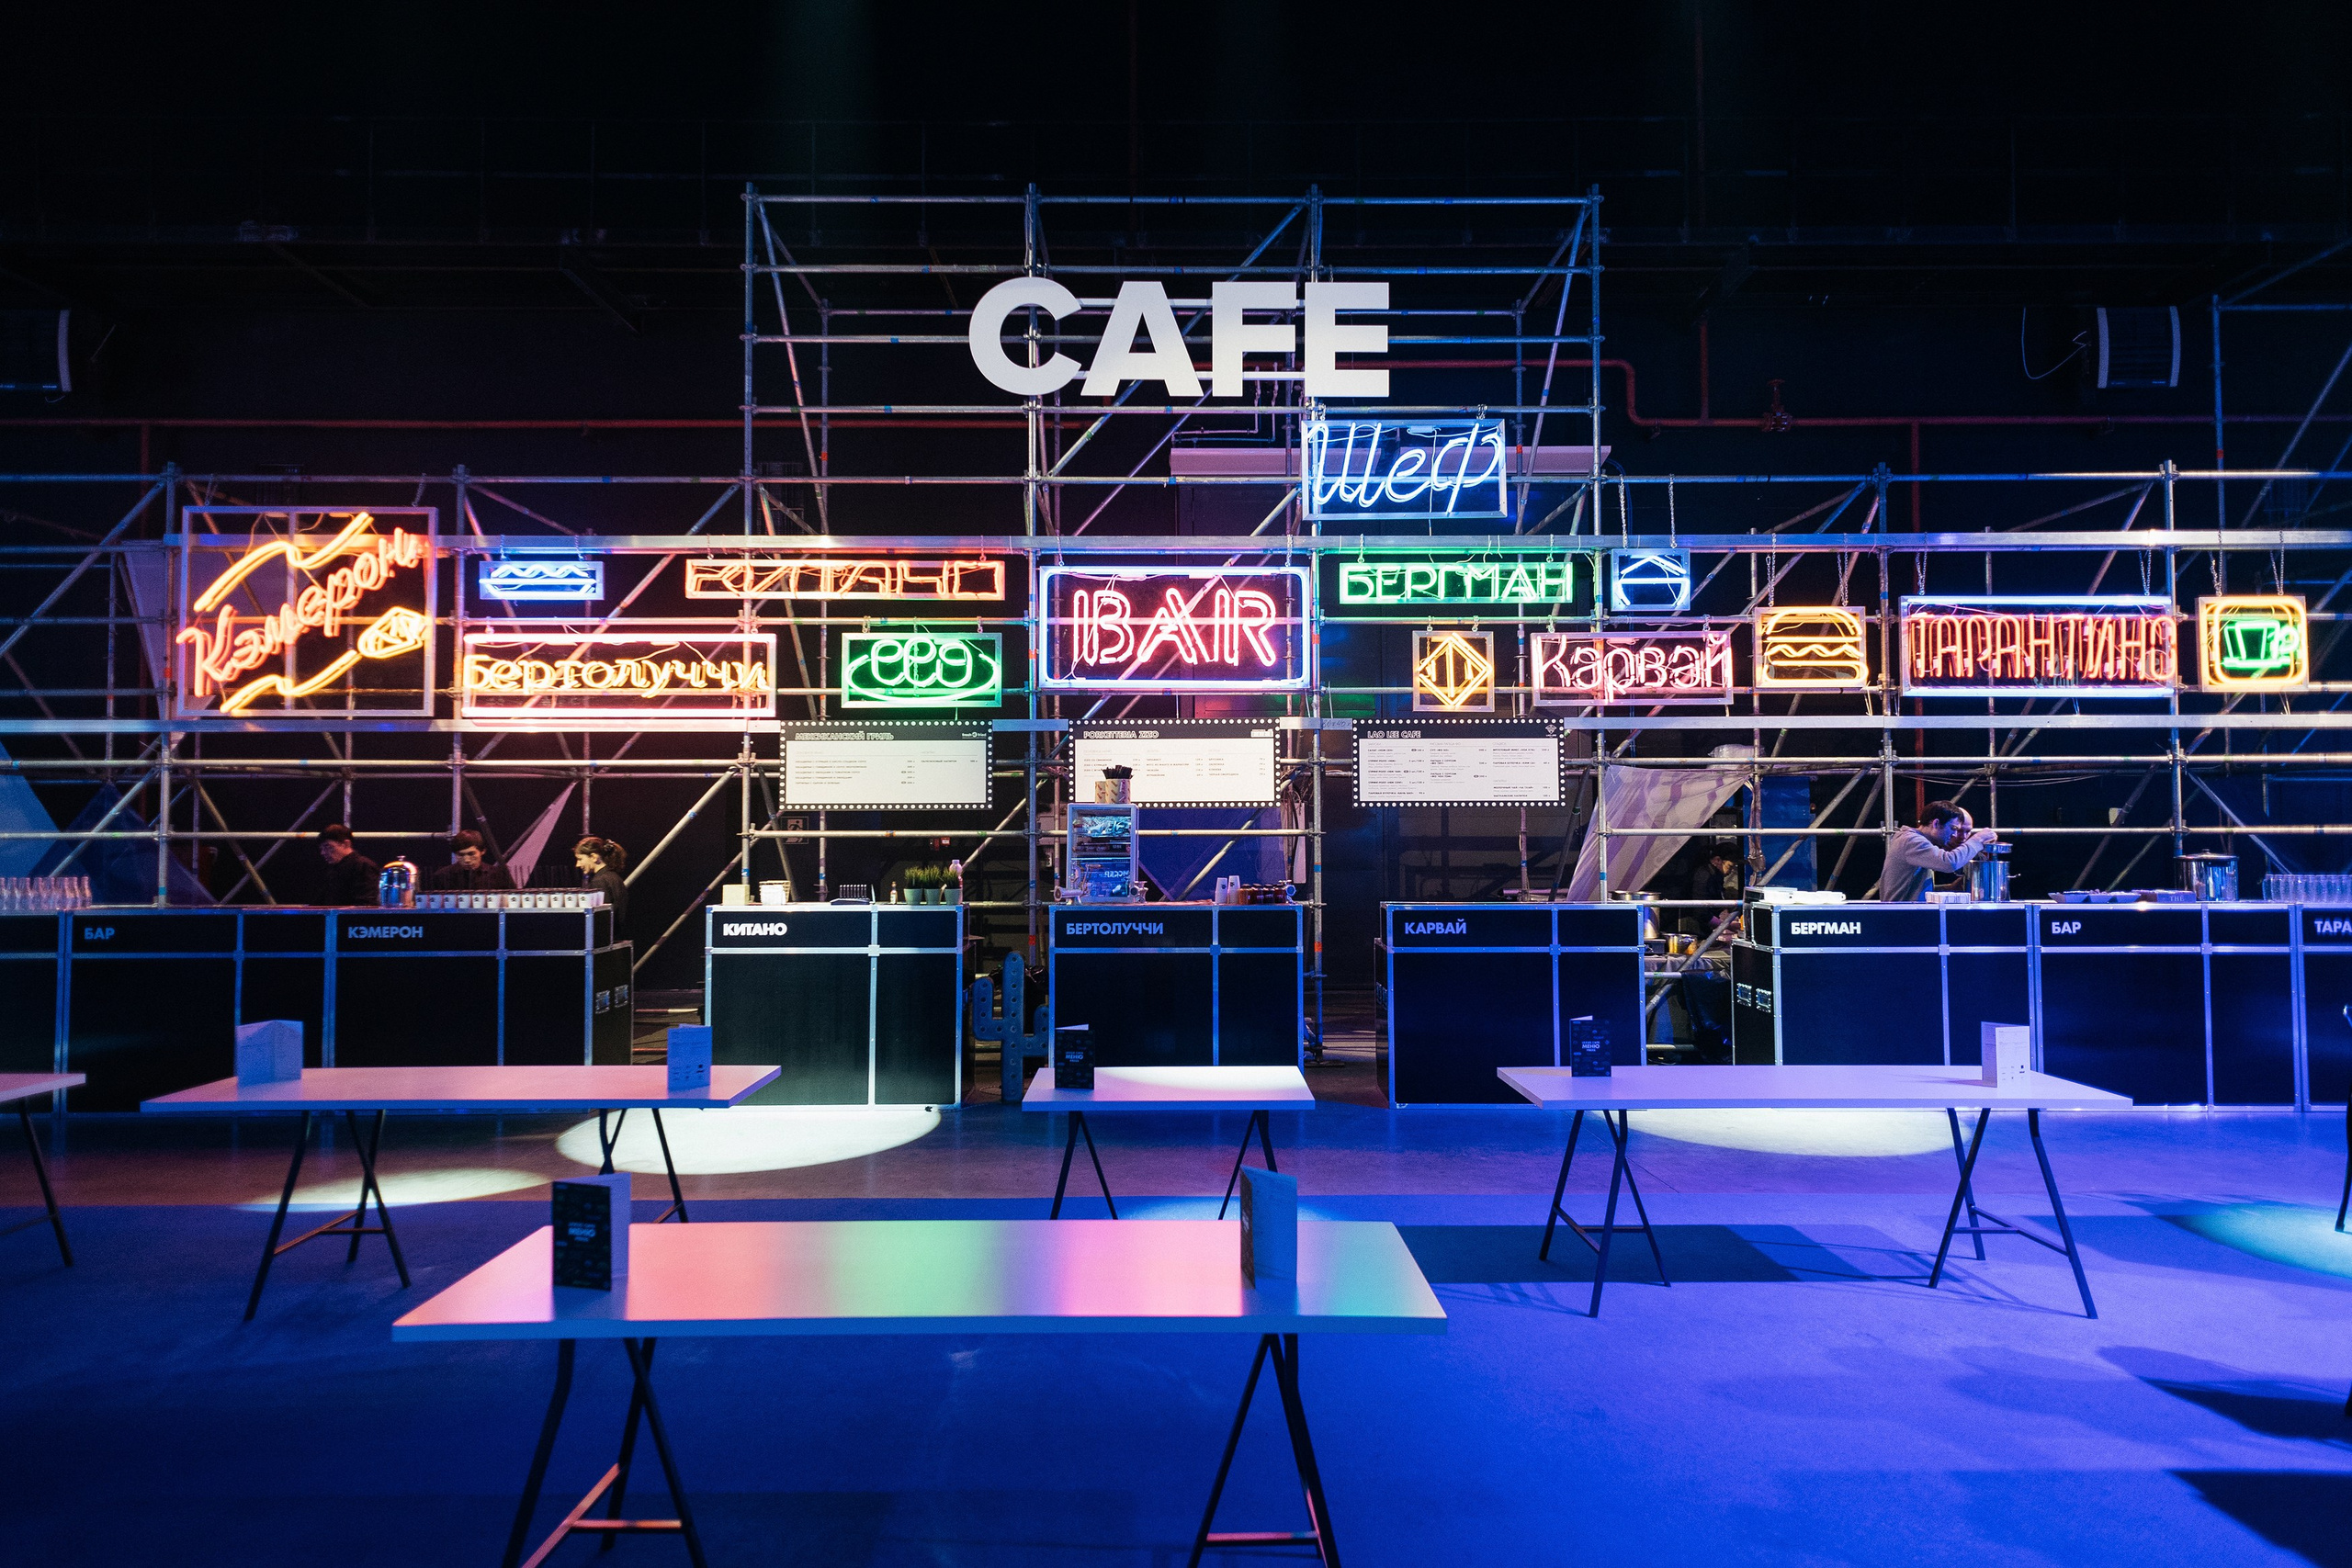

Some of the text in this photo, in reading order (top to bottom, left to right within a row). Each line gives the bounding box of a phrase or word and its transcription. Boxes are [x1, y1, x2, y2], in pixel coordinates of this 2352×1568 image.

[969, 276, 1391, 398] CAFE
[1308, 422, 1501, 513] Шеф
[687, 559, 1003, 598] КИТАНО
[1342, 562, 1573, 601] БЕРГМАН
[175, 526, 423, 697] Кэмерон
[1072, 588, 1277, 667] BAR
[1906, 612, 2177, 680] ТАРАНТИНО
[1533, 632, 1733, 704] Карвай
[463, 654, 770, 698] Бертолуччи
[795, 730, 894, 740] МЕКСИКАНСКИЙ ГРИЛЬ
[1083, 730, 1137, 739] PORKETTERIA
[1367, 730, 1421, 739] LAO LEE CAFE
[85, 927, 115, 940] БАР
[348, 925, 424, 939] КЭМЕРОН
[722, 922, 788, 936] КИТАНО
[1066, 922, 1164, 935] БЕРТОЛУЧЧИ
[1404, 919, 1467, 935] КАРВАЙ
[1791, 921, 1861, 935] БЕРГМАН
[2051, 920, 2083, 935] БАР
[2313, 920, 2352, 933] ТАРА
